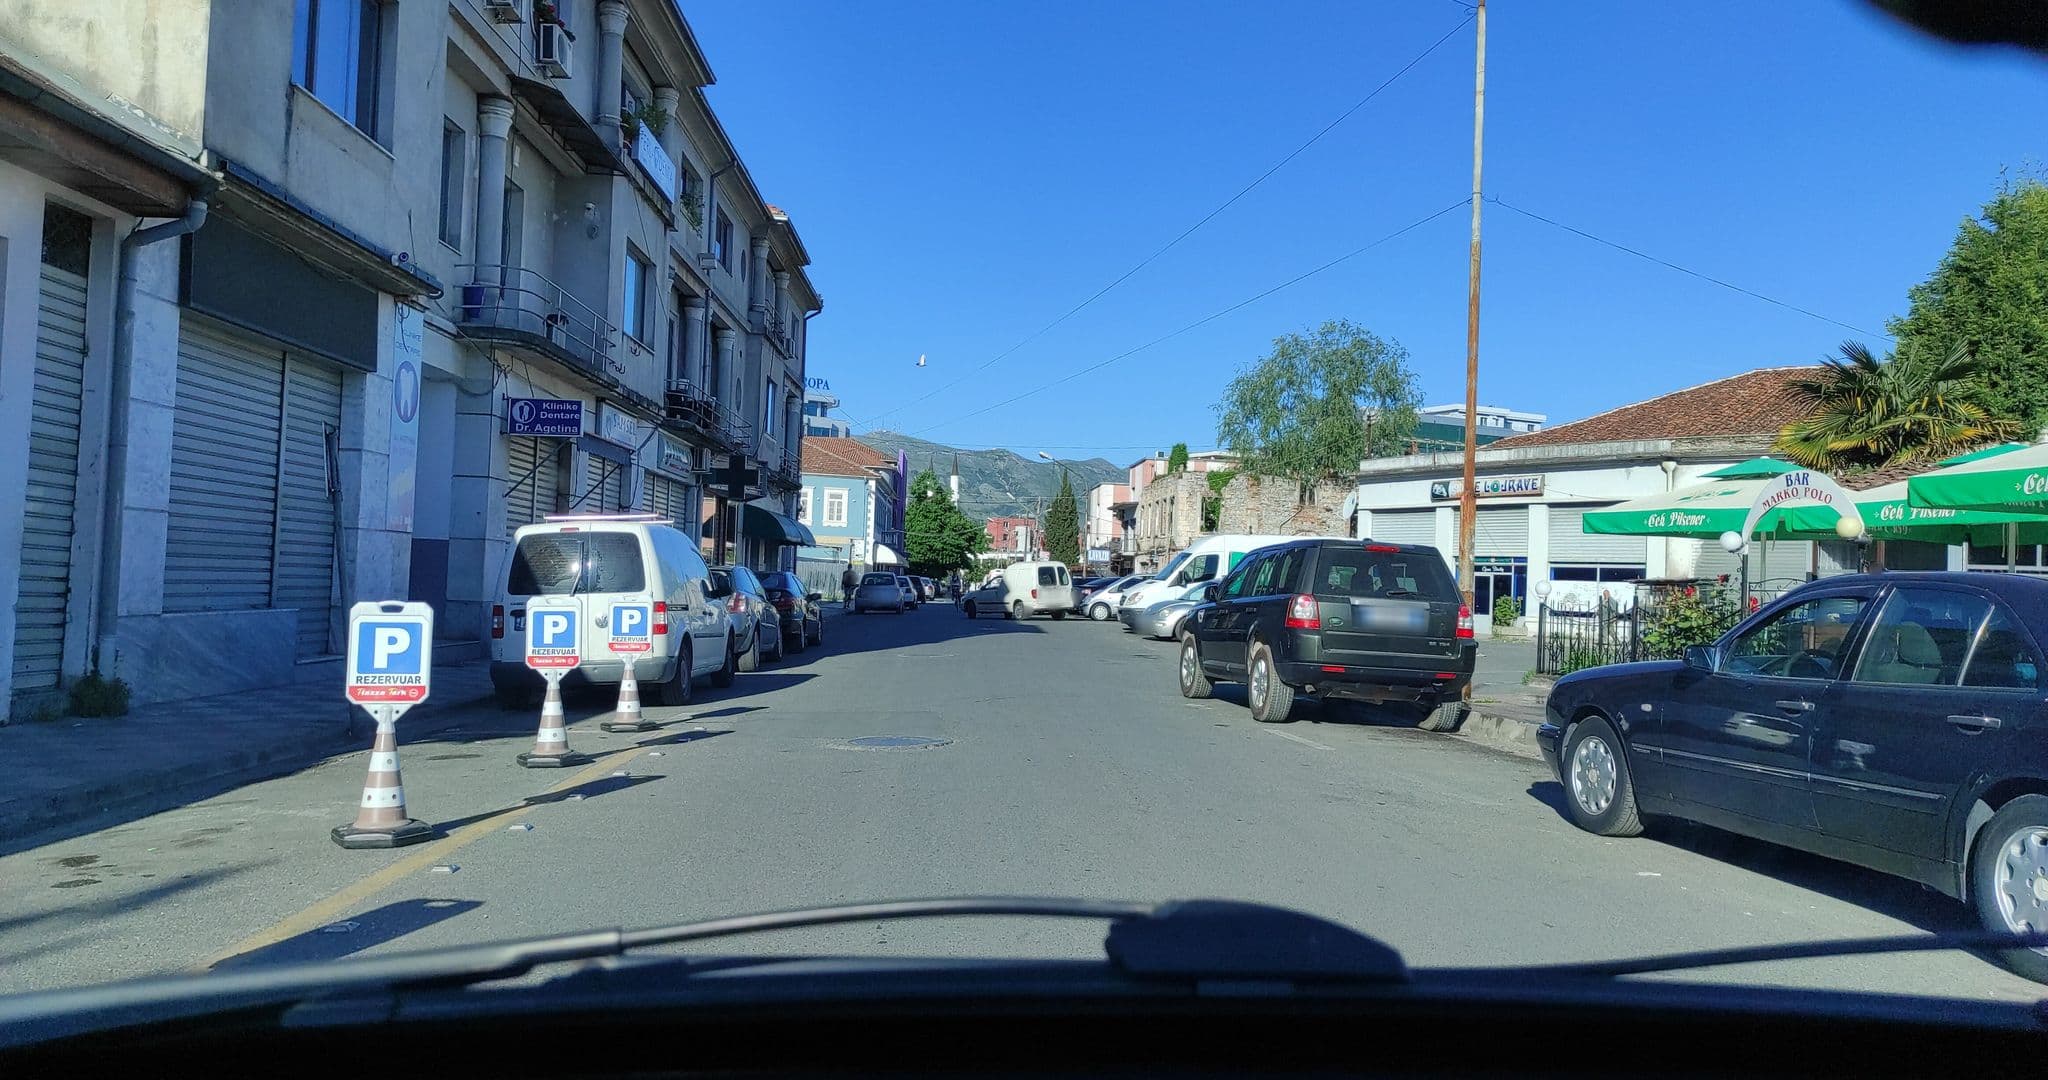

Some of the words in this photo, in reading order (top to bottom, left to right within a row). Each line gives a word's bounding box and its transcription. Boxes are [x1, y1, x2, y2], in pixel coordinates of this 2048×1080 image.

[543, 402, 578, 410] Klinike
[540, 411, 580, 419] Dentare
[515, 423, 531, 432] Dr.
[1785, 472, 1810, 487] BAR
[1762, 487, 1799, 510] MARKO
[1804, 487, 1833, 504] POLO
[621, 609, 642, 634] P
[543, 614, 568, 645] P
[374, 627, 411, 669] P
[532, 648, 576, 656] REZERVUAR
[356, 675, 422, 685] REZERVUAR
